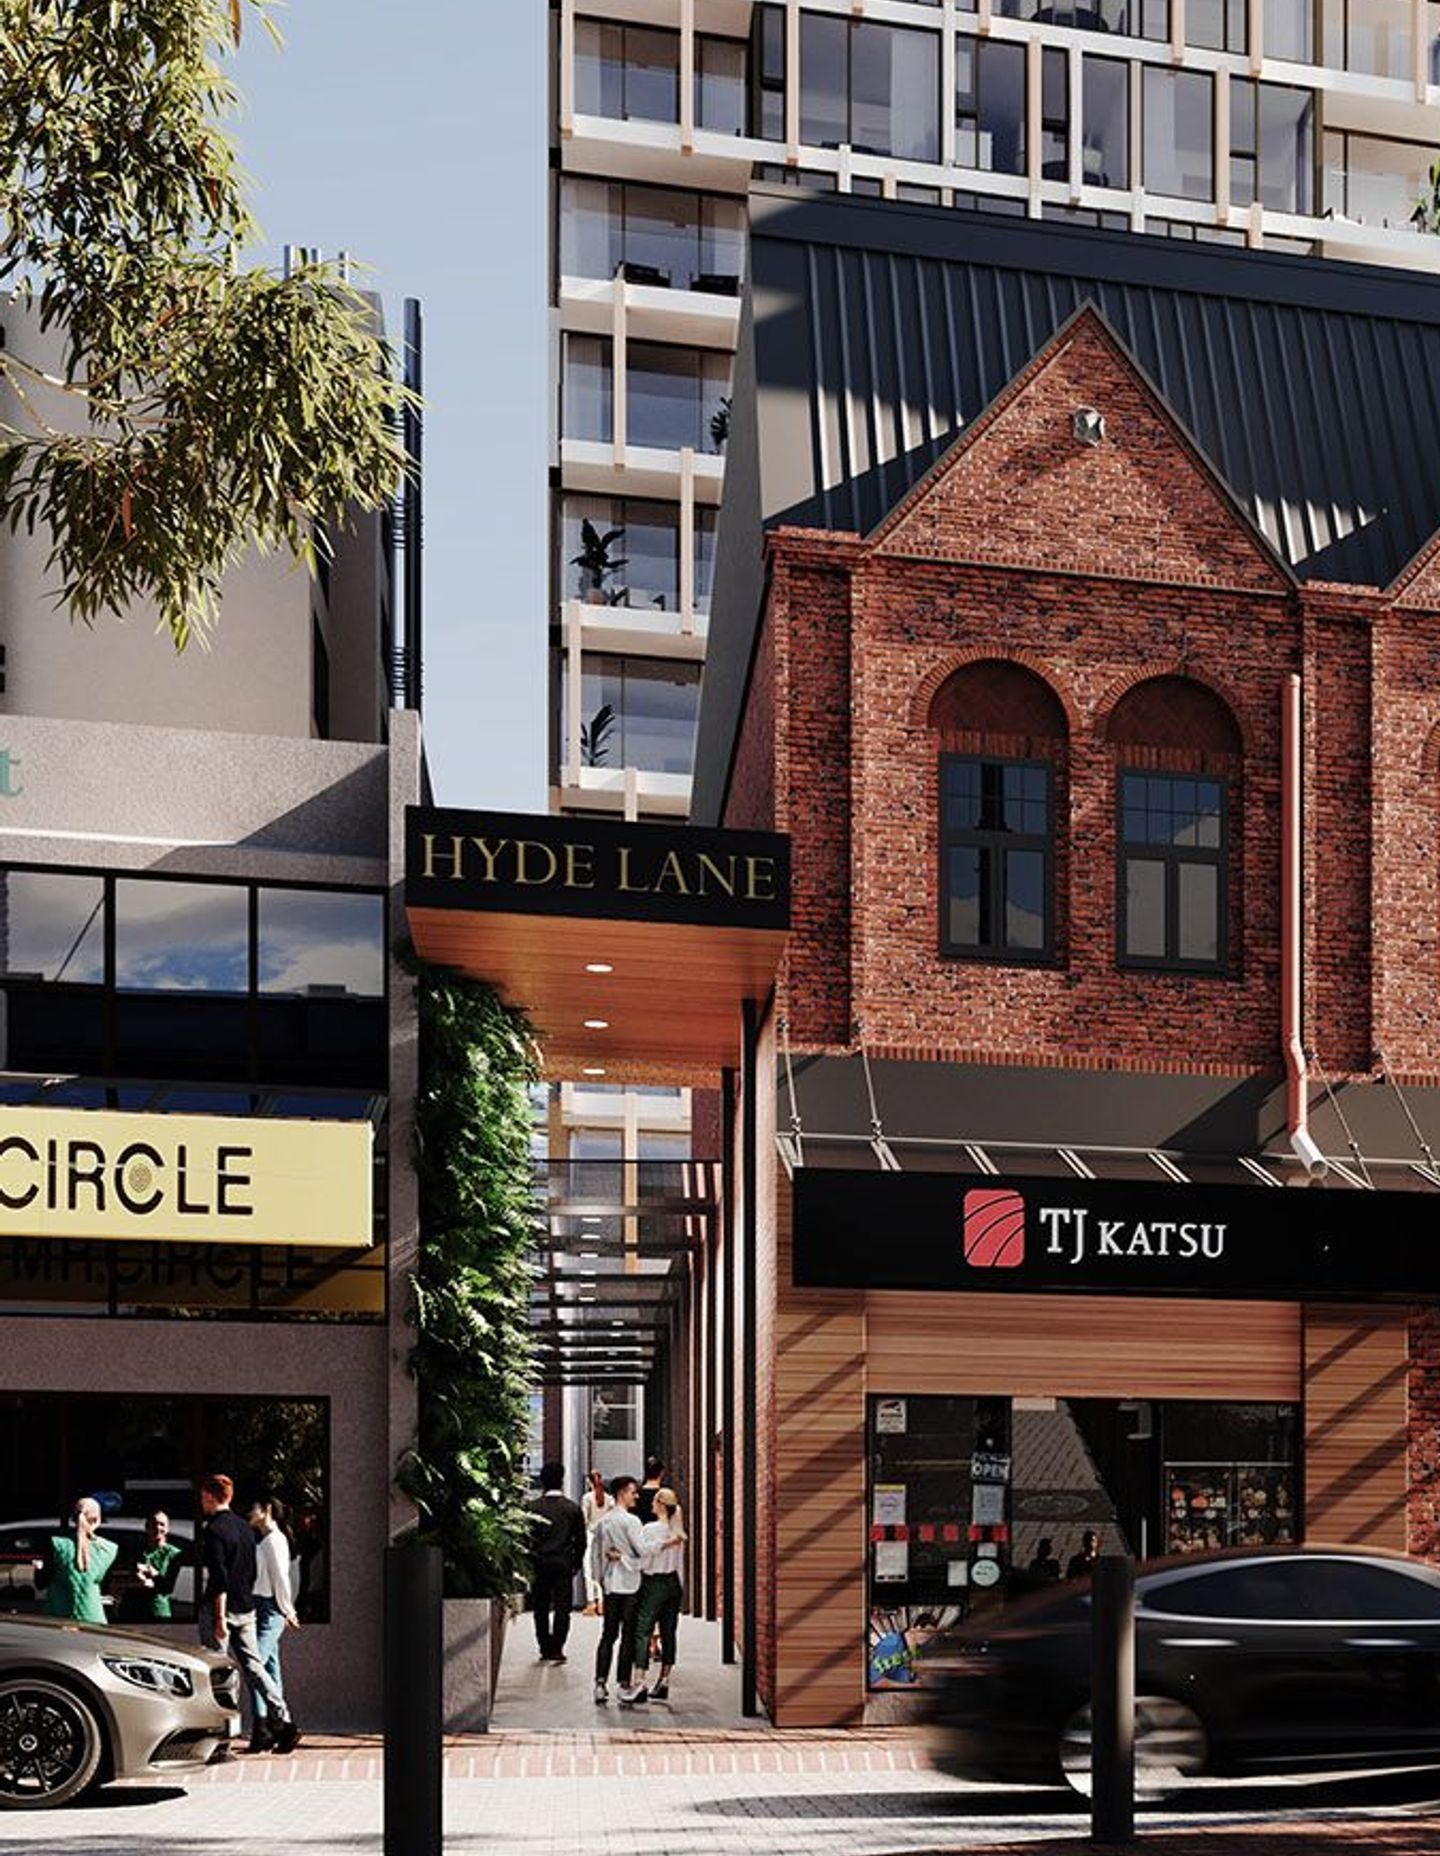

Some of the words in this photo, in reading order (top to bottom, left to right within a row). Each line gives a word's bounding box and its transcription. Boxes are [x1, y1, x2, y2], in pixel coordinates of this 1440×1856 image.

[420, 833, 595, 889] HYDE
[616, 846, 775, 900] LANE
[0, 1136, 253, 1216] CIRCLE
[1039, 1207, 1089, 1265] TJ
[1097, 1221, 1228, 1258] KATSU
[972, 1463, 1009, 1480] OPEN
